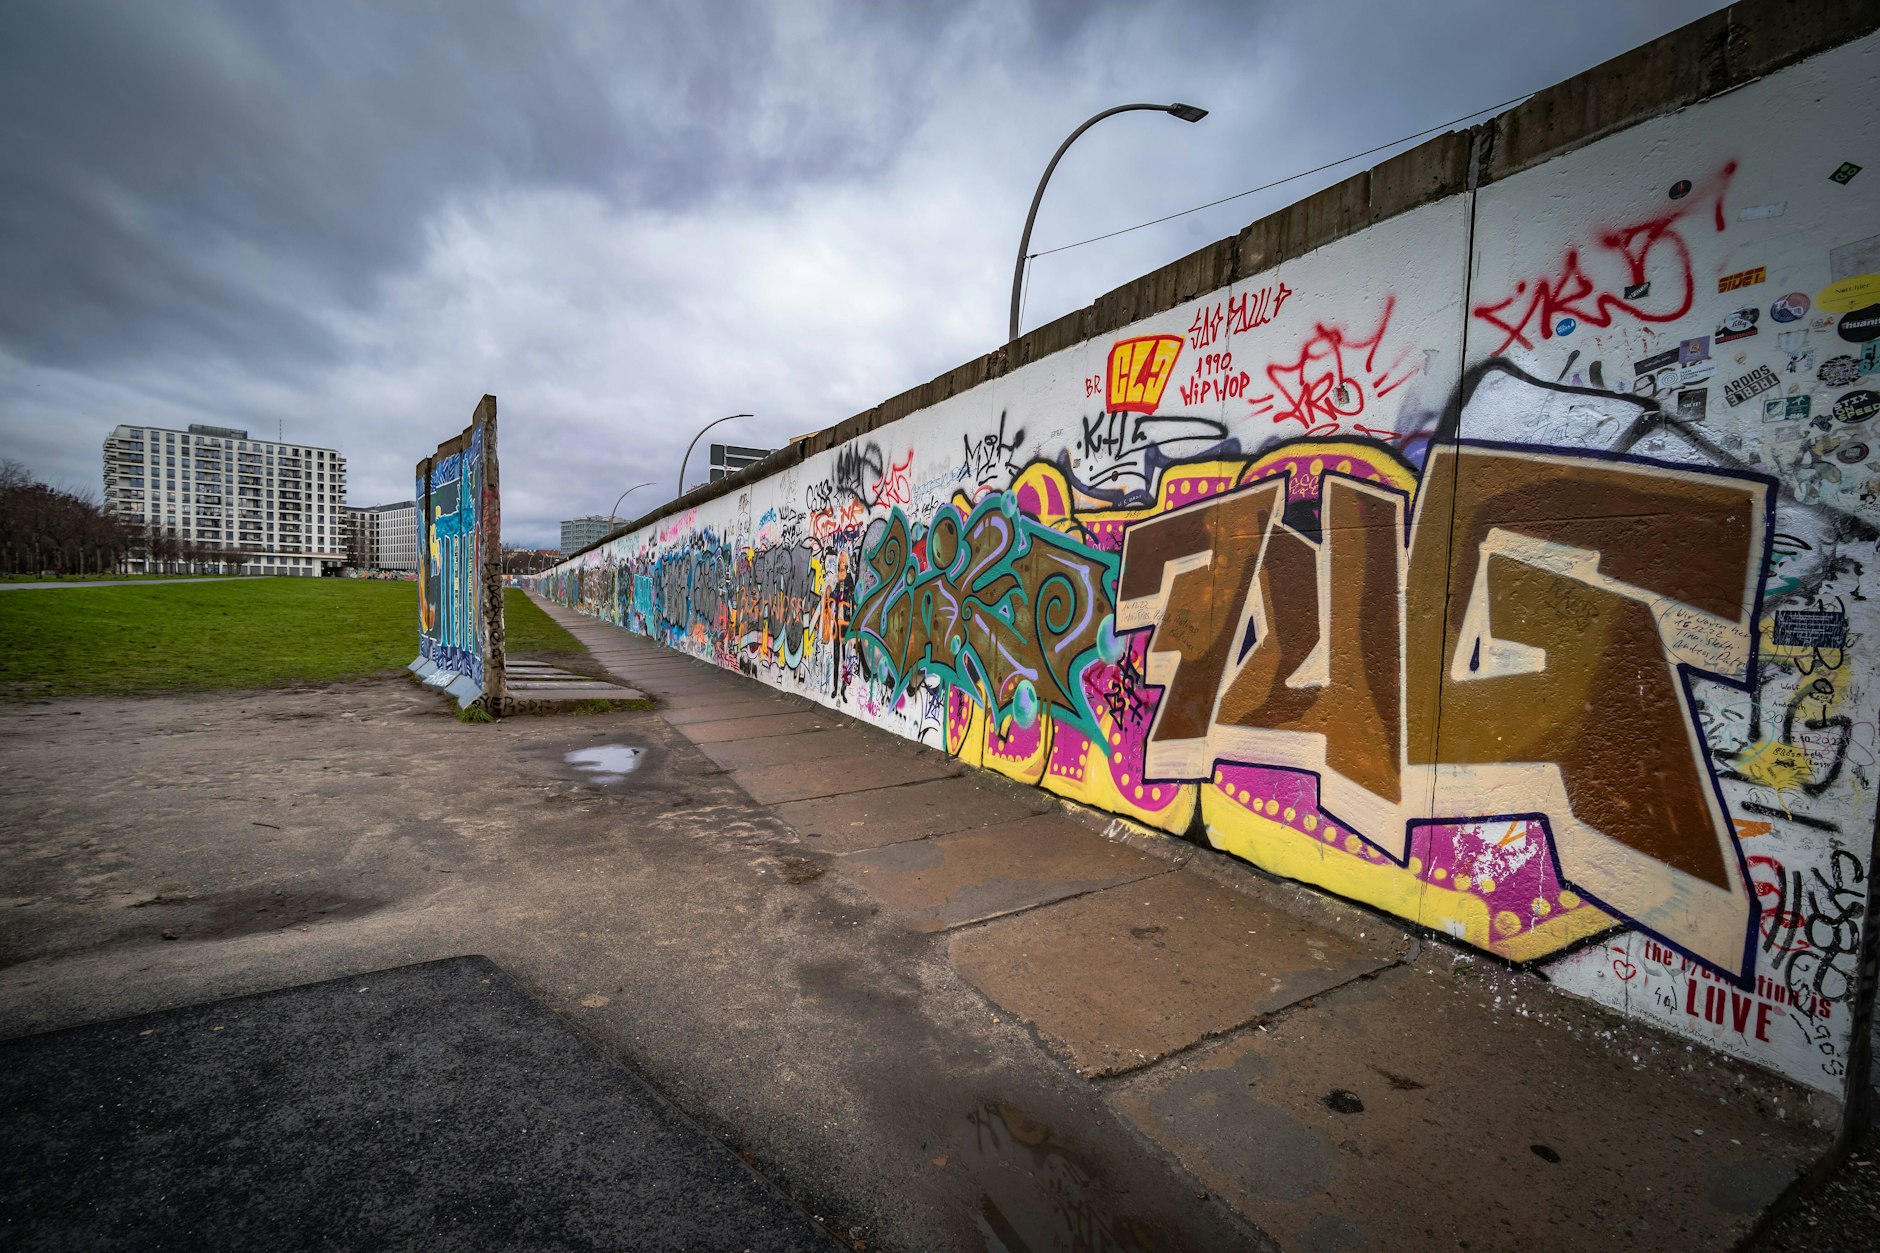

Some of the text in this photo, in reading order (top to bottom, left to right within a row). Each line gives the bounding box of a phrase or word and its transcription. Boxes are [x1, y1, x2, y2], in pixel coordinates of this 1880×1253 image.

[1723, 364, 1770, 395] ARDIOS
[1834, 393, 1869, 410] STIX
[1836, 405, 1854, 415] ON
[1838, 402, 1880, 422] SPEED
[1644, 939, 1673, 966] the
[1685, 978, 1773, 1043] LOVE
